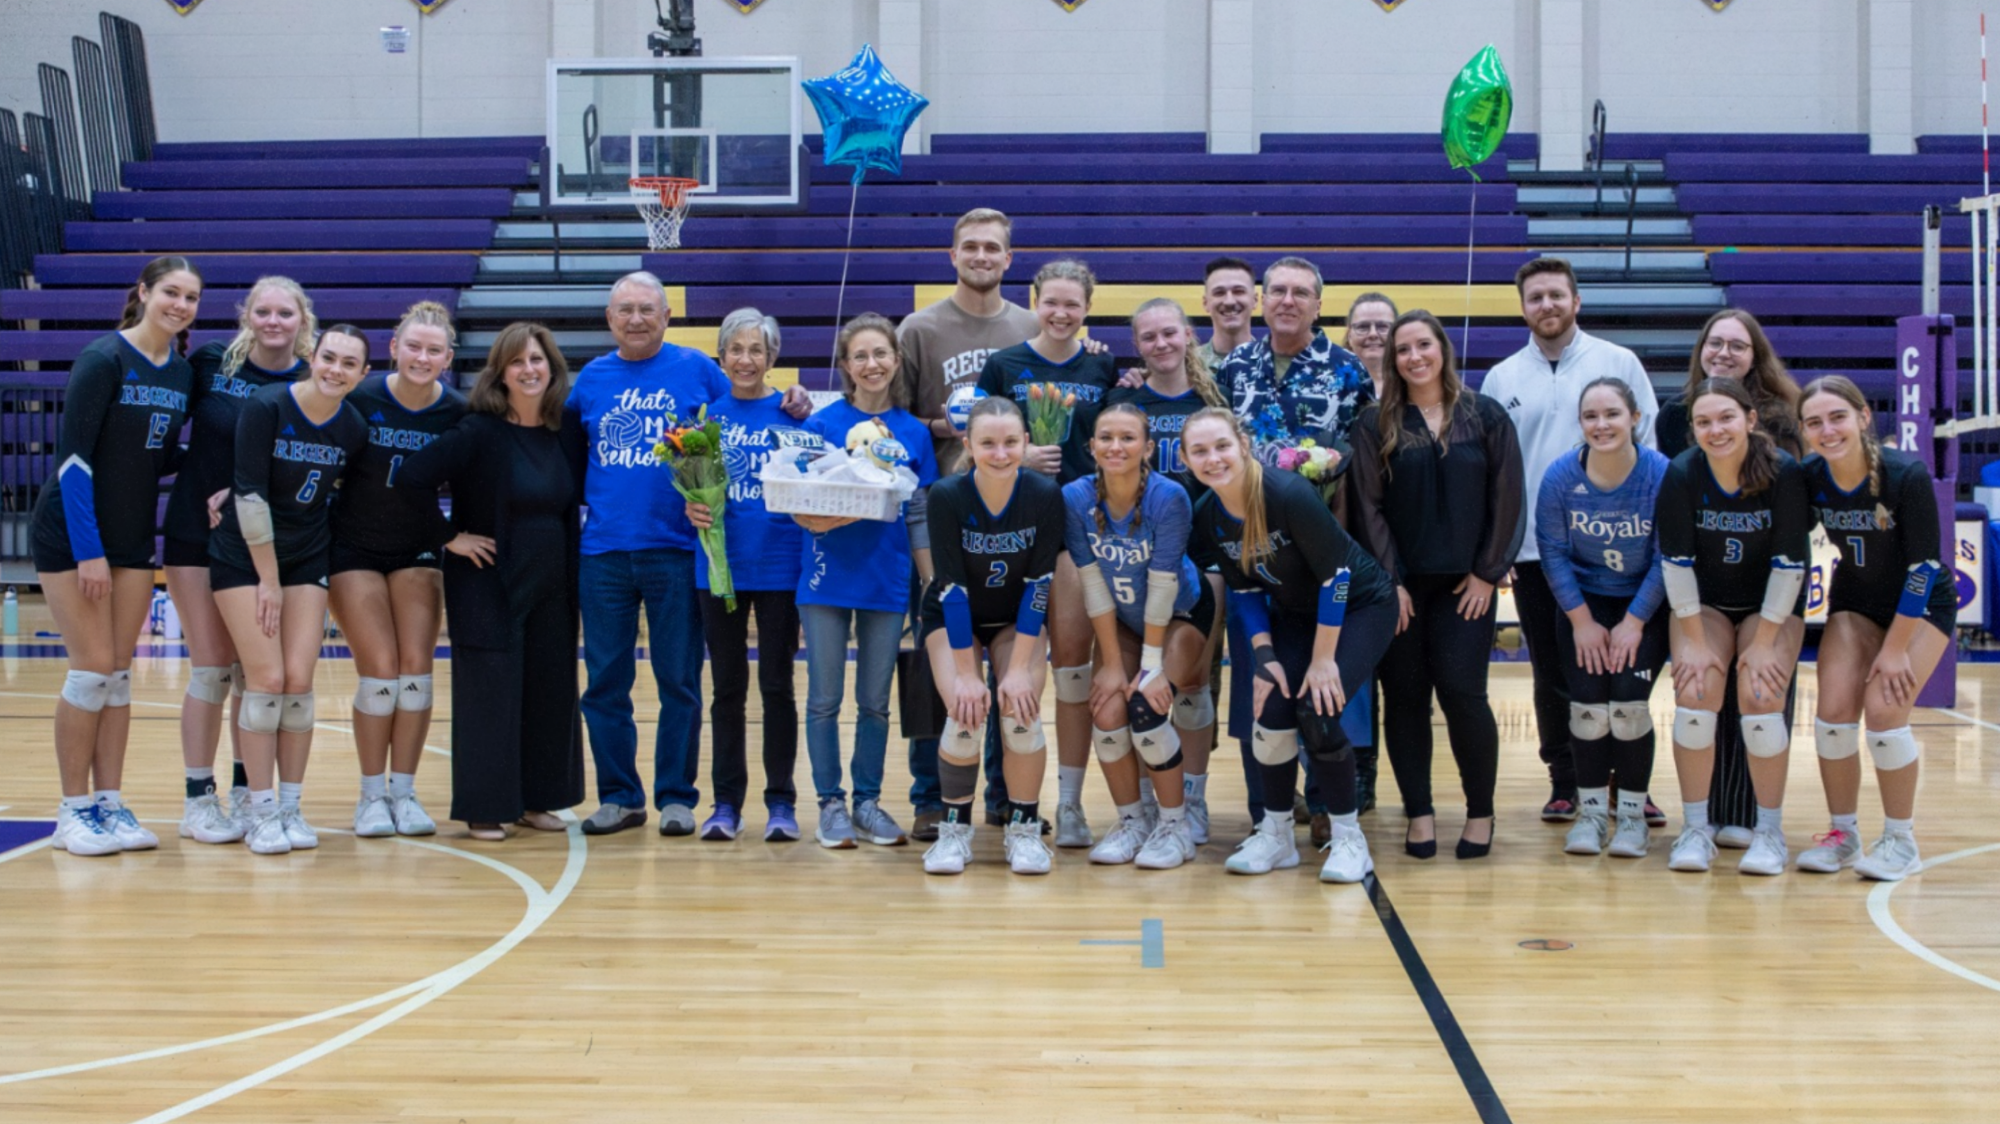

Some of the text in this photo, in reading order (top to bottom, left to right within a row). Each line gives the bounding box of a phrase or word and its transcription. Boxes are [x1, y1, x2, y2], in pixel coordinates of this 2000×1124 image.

[613, 387, 676, 411] that's
[145, 412, 171, 449] 15
[296, 469, 321, 504] 6
[1569, 509, 1653, 546] Royals
[1087, 532, 1154, 572] Royal
[1603, 548, 1625, 572] 8
[1723, 537, 1743, 563] 3
[1846, 535, 1866, 568] 7
[985, 560, 1008, 588] 2
[1113, 576, 1135, 605] 5
